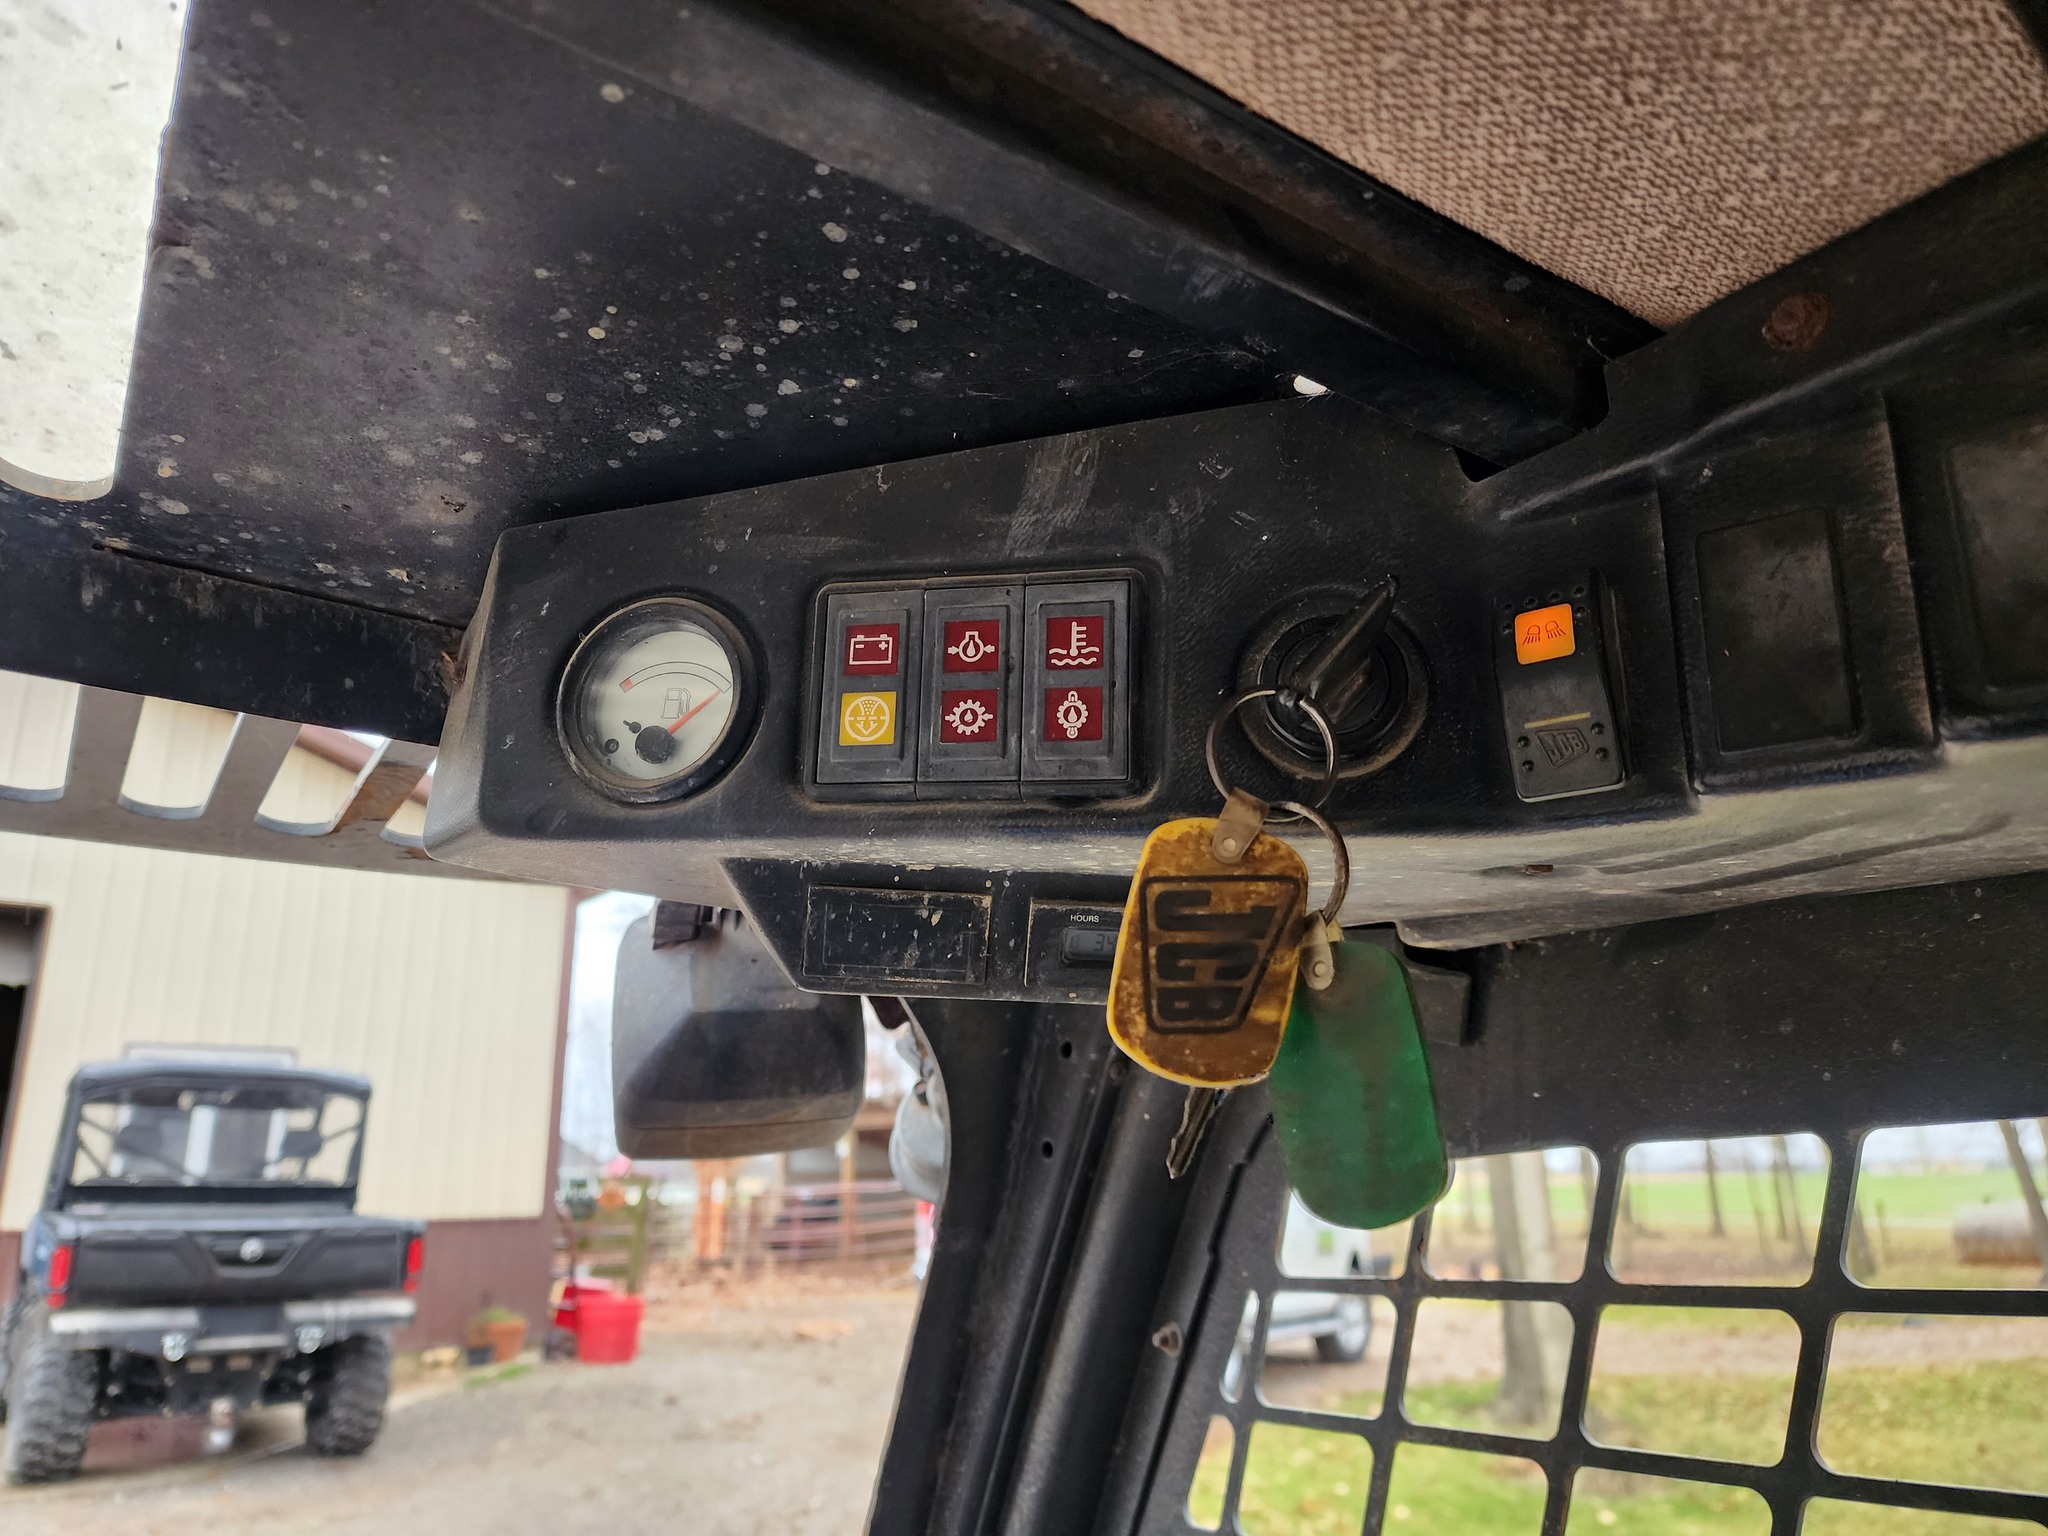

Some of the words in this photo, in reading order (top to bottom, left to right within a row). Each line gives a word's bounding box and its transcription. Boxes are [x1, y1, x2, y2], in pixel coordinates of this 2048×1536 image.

[1543, 730, 1584, 763] JCB
[1070, 914, 1100, 923] HOURS
[1154, 889, 1279, 1022] JCB
